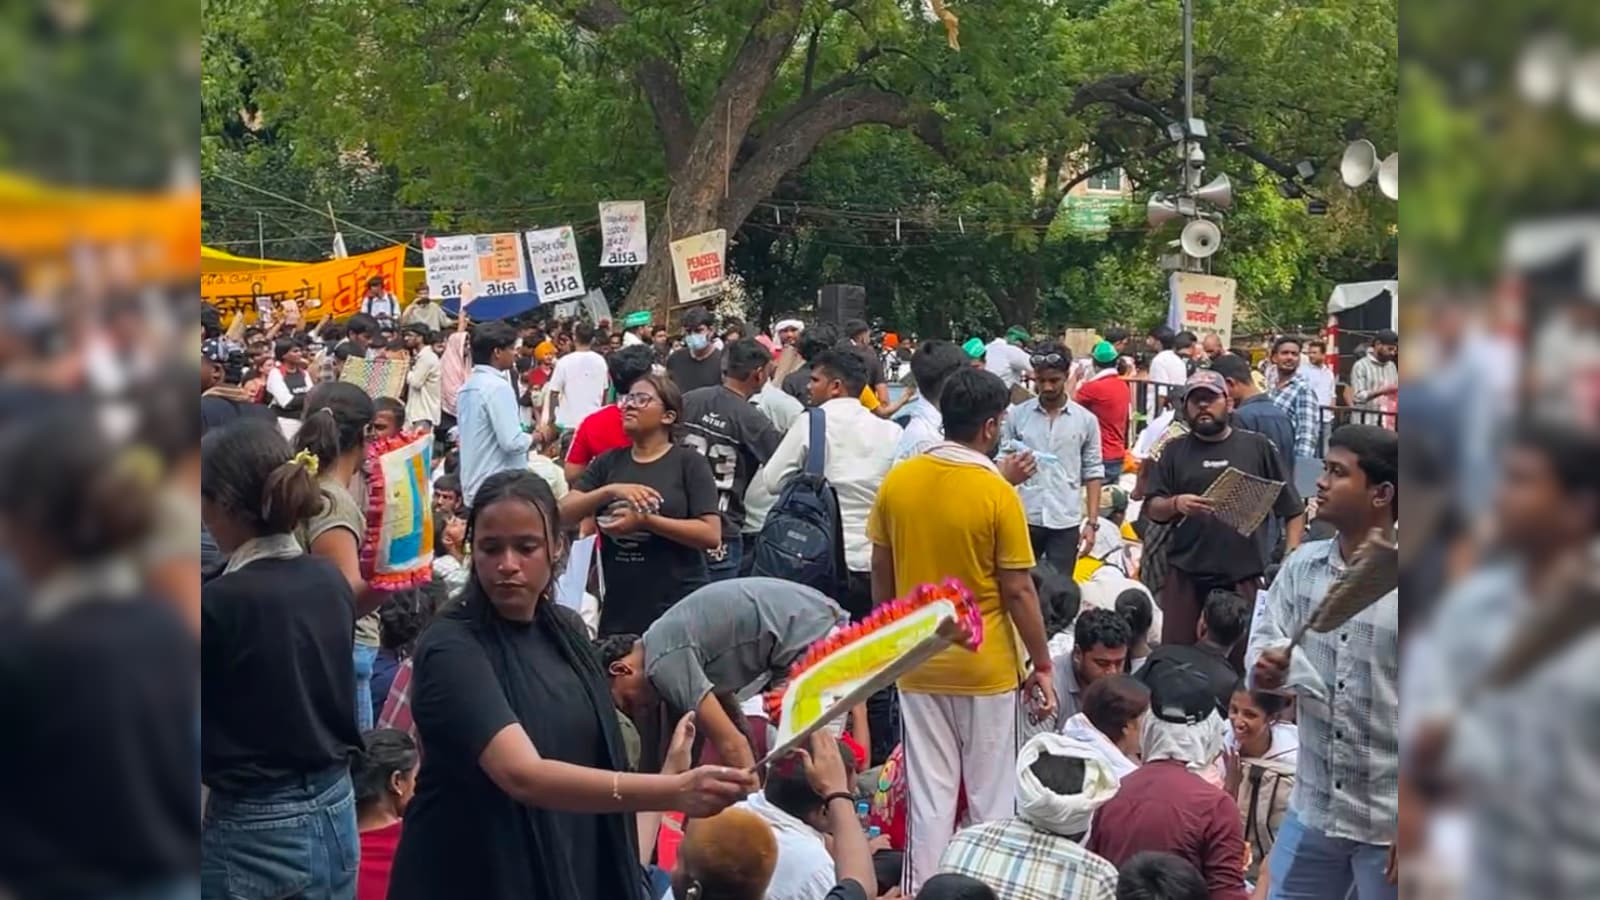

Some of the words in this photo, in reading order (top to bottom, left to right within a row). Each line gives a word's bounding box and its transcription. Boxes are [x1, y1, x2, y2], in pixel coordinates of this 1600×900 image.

[608, 248, 638, 263] aisa
[687, 252, 720, 269] PEACEFUL
[690, 264, 722, 284] PROTEST
[486, 279, 518, 295] aisa
[544, 274, 579, 295] aisa
